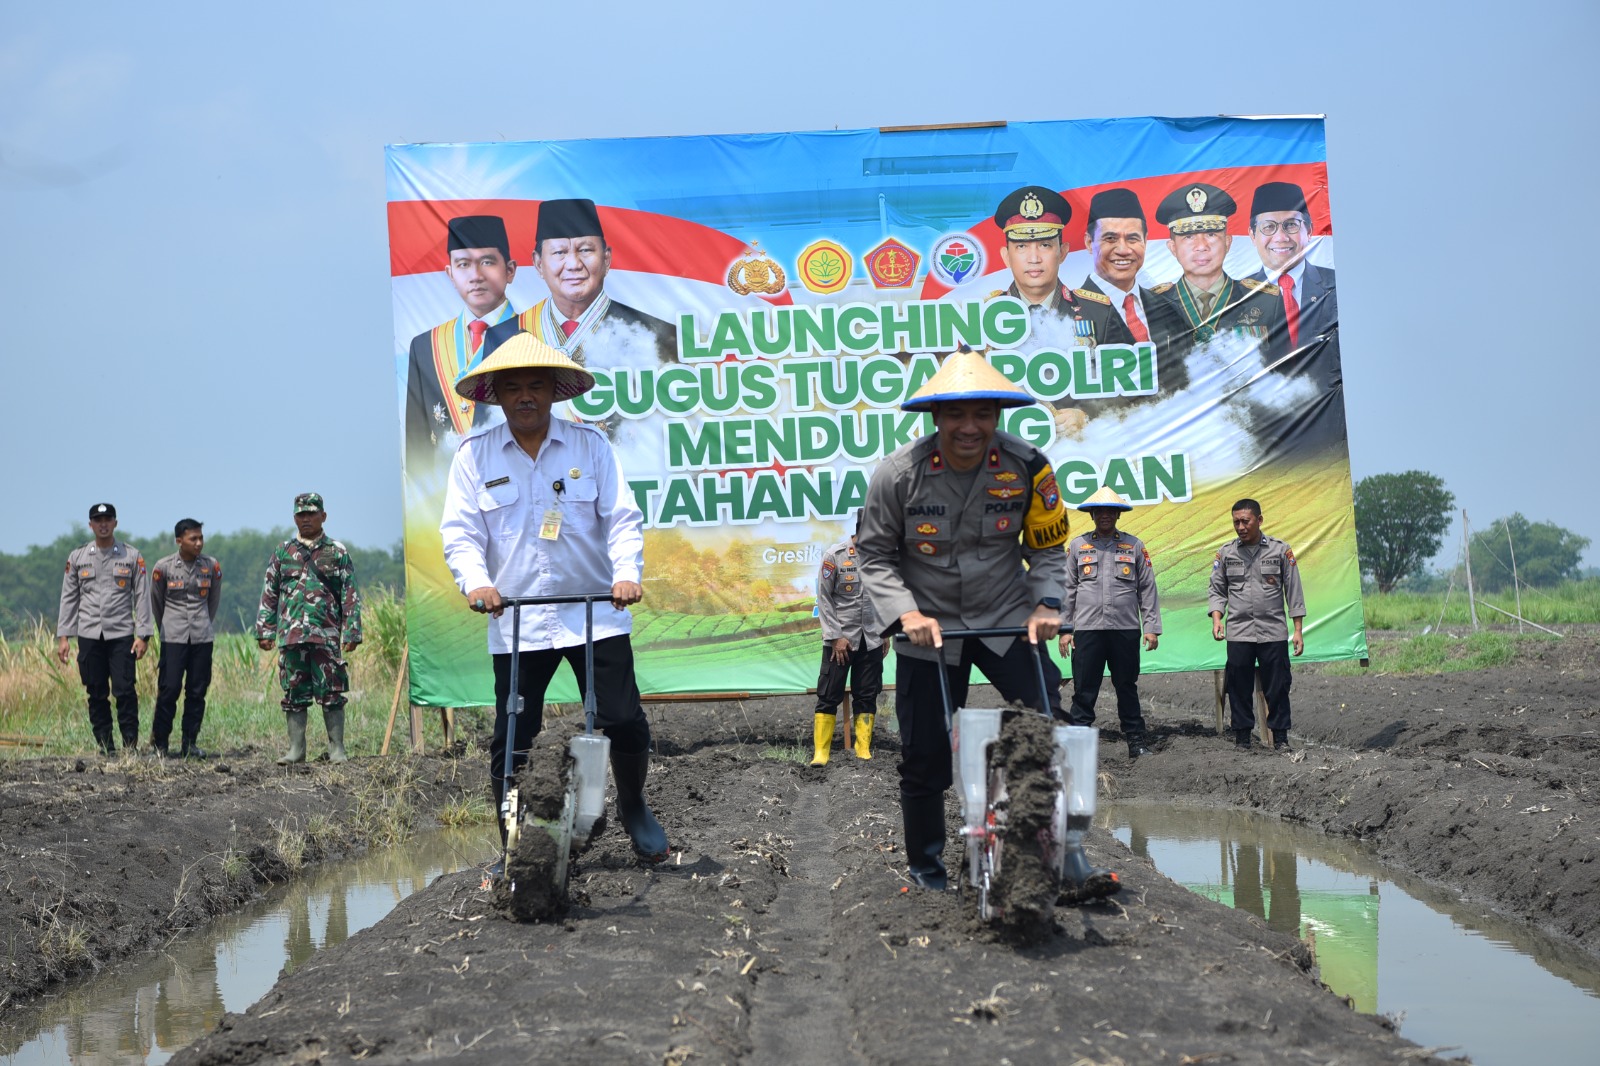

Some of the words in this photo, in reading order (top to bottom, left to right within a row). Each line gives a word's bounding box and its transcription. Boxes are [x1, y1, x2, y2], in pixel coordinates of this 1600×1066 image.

[679, 299, 1028, 359] LAUNCHING
[571, 362, 777, 417] GUGUS
[782, 357, 938, 408] TUGA
[990, 345, 1155, 398] POLRI
[666, 406, 1051, 467] MENDUKG
[627, 469, 869, 525] TAHANA
[1055, 453, 1188, 505] GAN
[907, 505, 946, 517] DANU
[984, 501, 1024, 514] POLRI
[762, 543, 822, 565] Gresik
